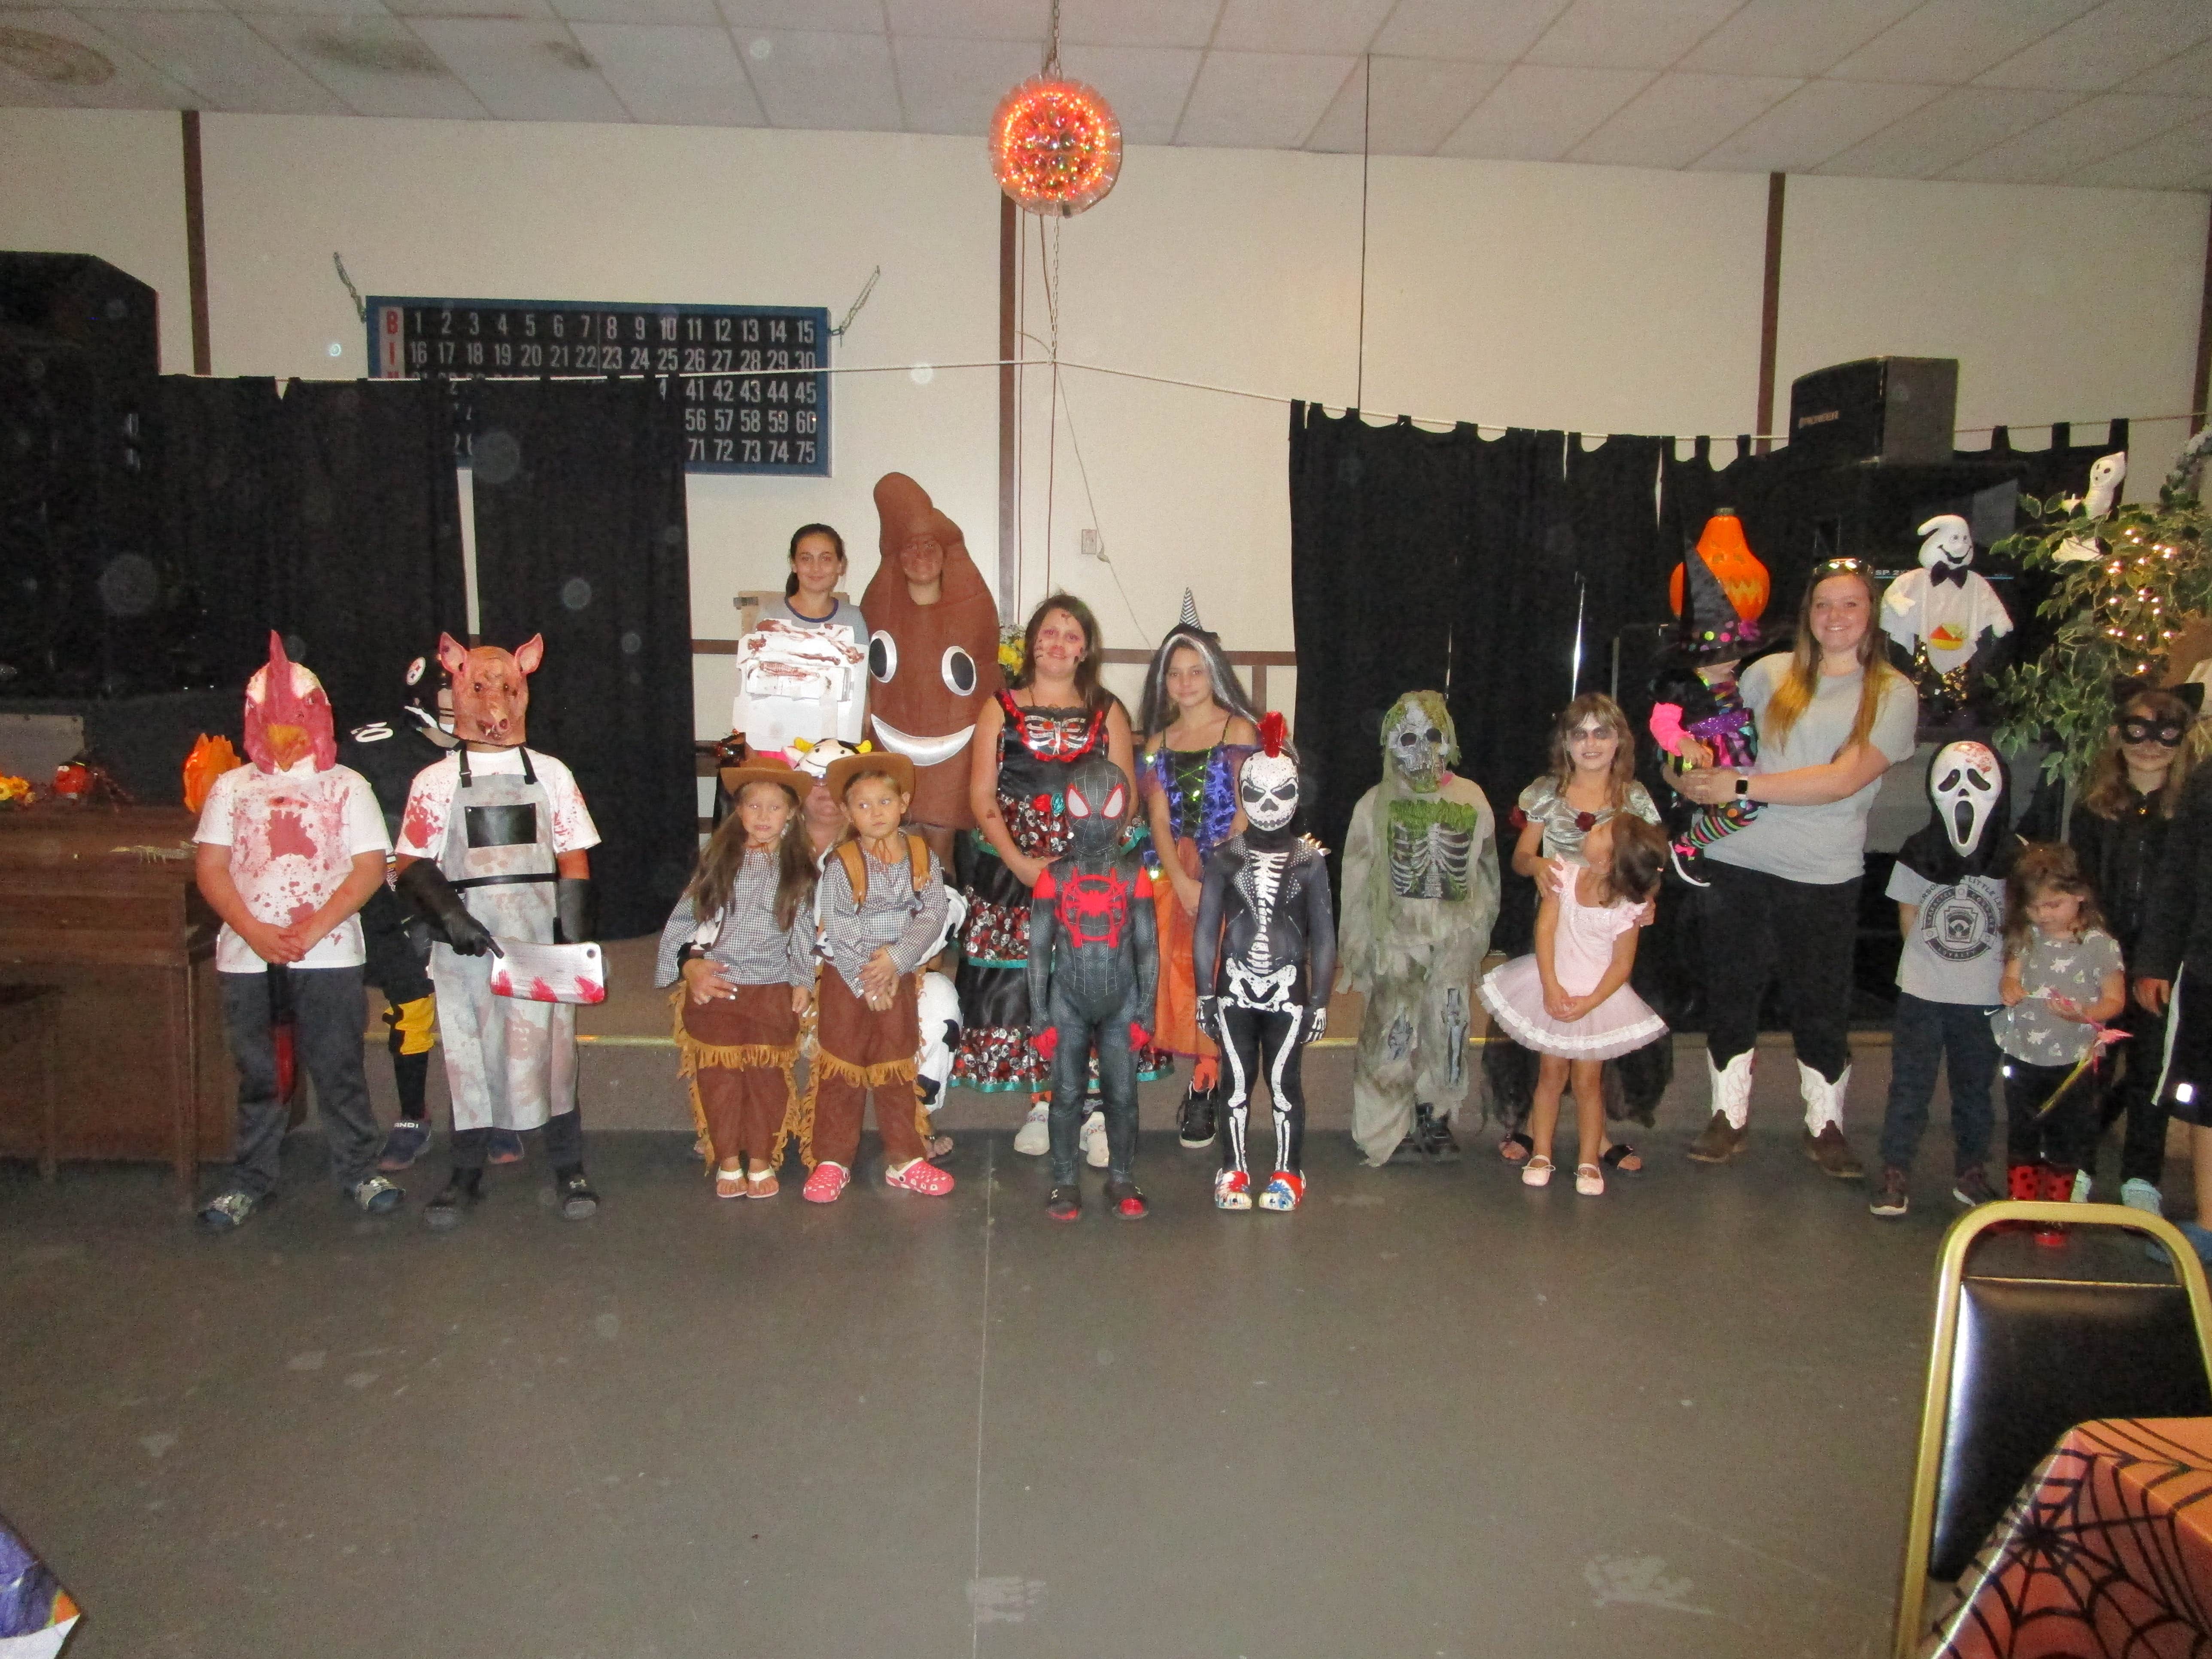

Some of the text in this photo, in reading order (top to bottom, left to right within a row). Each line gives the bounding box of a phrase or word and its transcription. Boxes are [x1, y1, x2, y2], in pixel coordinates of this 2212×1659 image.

[386, 311, 813, 343] B 1 2 3 4 5 6 7 8 9 10 11 12 13 14 15
[410, 341, 427, 363] 16
[438, 342, 454, 364] 17
[467, 343, 483, 365] 18
[494, 344, 511, 365] 19
[521, 345, 541, 367] 20
[550, 345, 568, 368] 21
[575, 346, 596, 368] 22
[603, 347, 622, 368] 23
[631, 347, 649, 370] 24
[658, 348, 678, 371] 25
[684, 348, 705, 372] 26
[712, 350, 732, 371] 27
[740, 350, 760, 371] 28
[767, 350, 788, 370] 29
[795, 351, 815, 369] 30
[687, 379, 704, 401] 41
[713, 380, 734, 401] 42
[740, 380, 760, 403] 43
[768, 381, 788, 403] 44
[795, 382, 815, 404] 45
[685, 409, 816, 433] 56 57 58 59 60
[689, 439, 815, 463] 71 72 73 74 75
[1969, 876, 1996, 896] LITTLE
